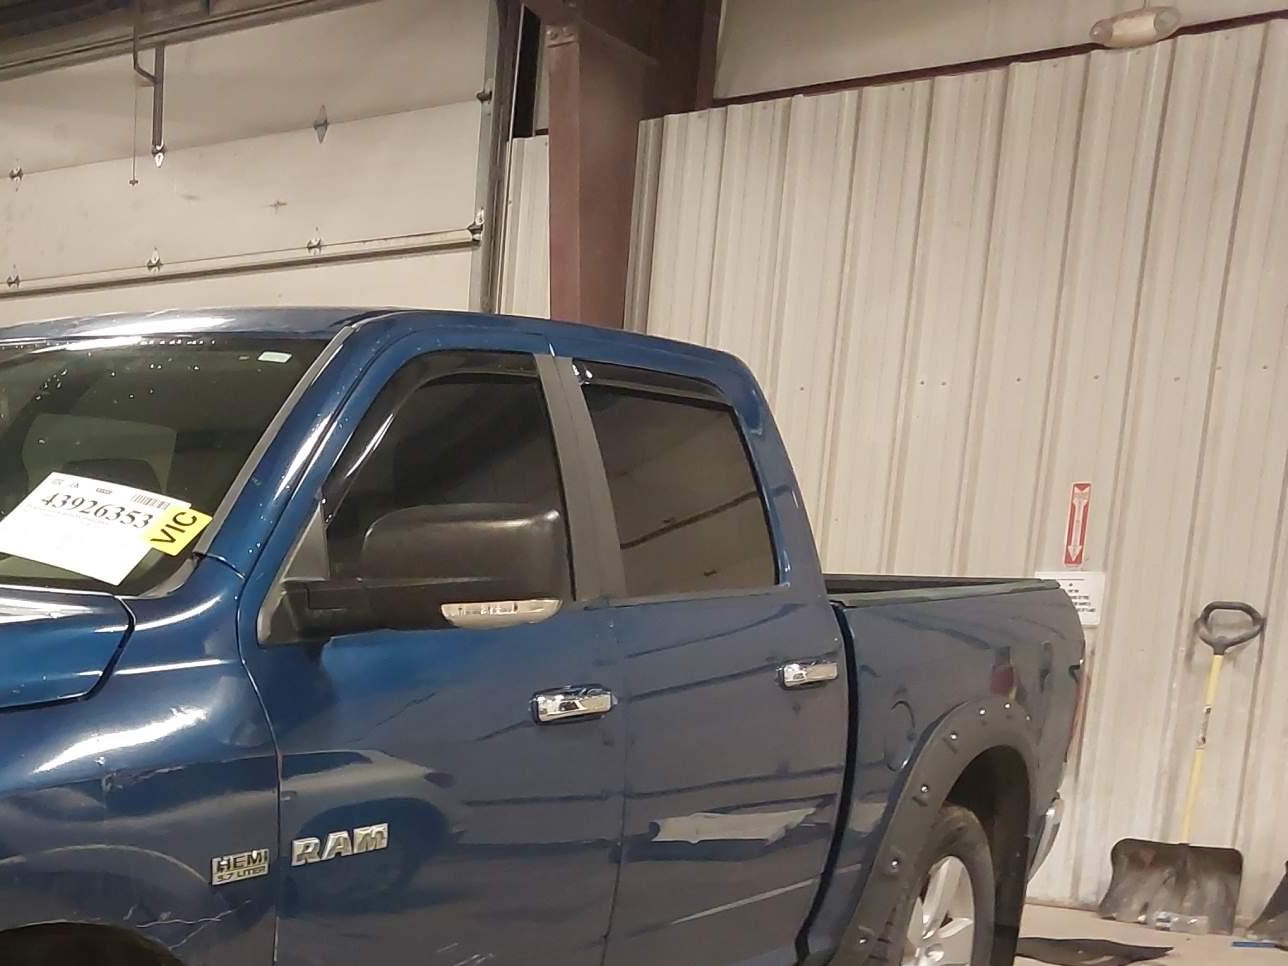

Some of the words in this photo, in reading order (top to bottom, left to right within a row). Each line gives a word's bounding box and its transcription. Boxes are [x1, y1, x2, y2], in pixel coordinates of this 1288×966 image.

[41, 492, 154, 529] 43926353
[150, 511, 198, 544] VIC
[216, 850, 268, 873] HEMI
[291, 822, 389, 867] RAM
